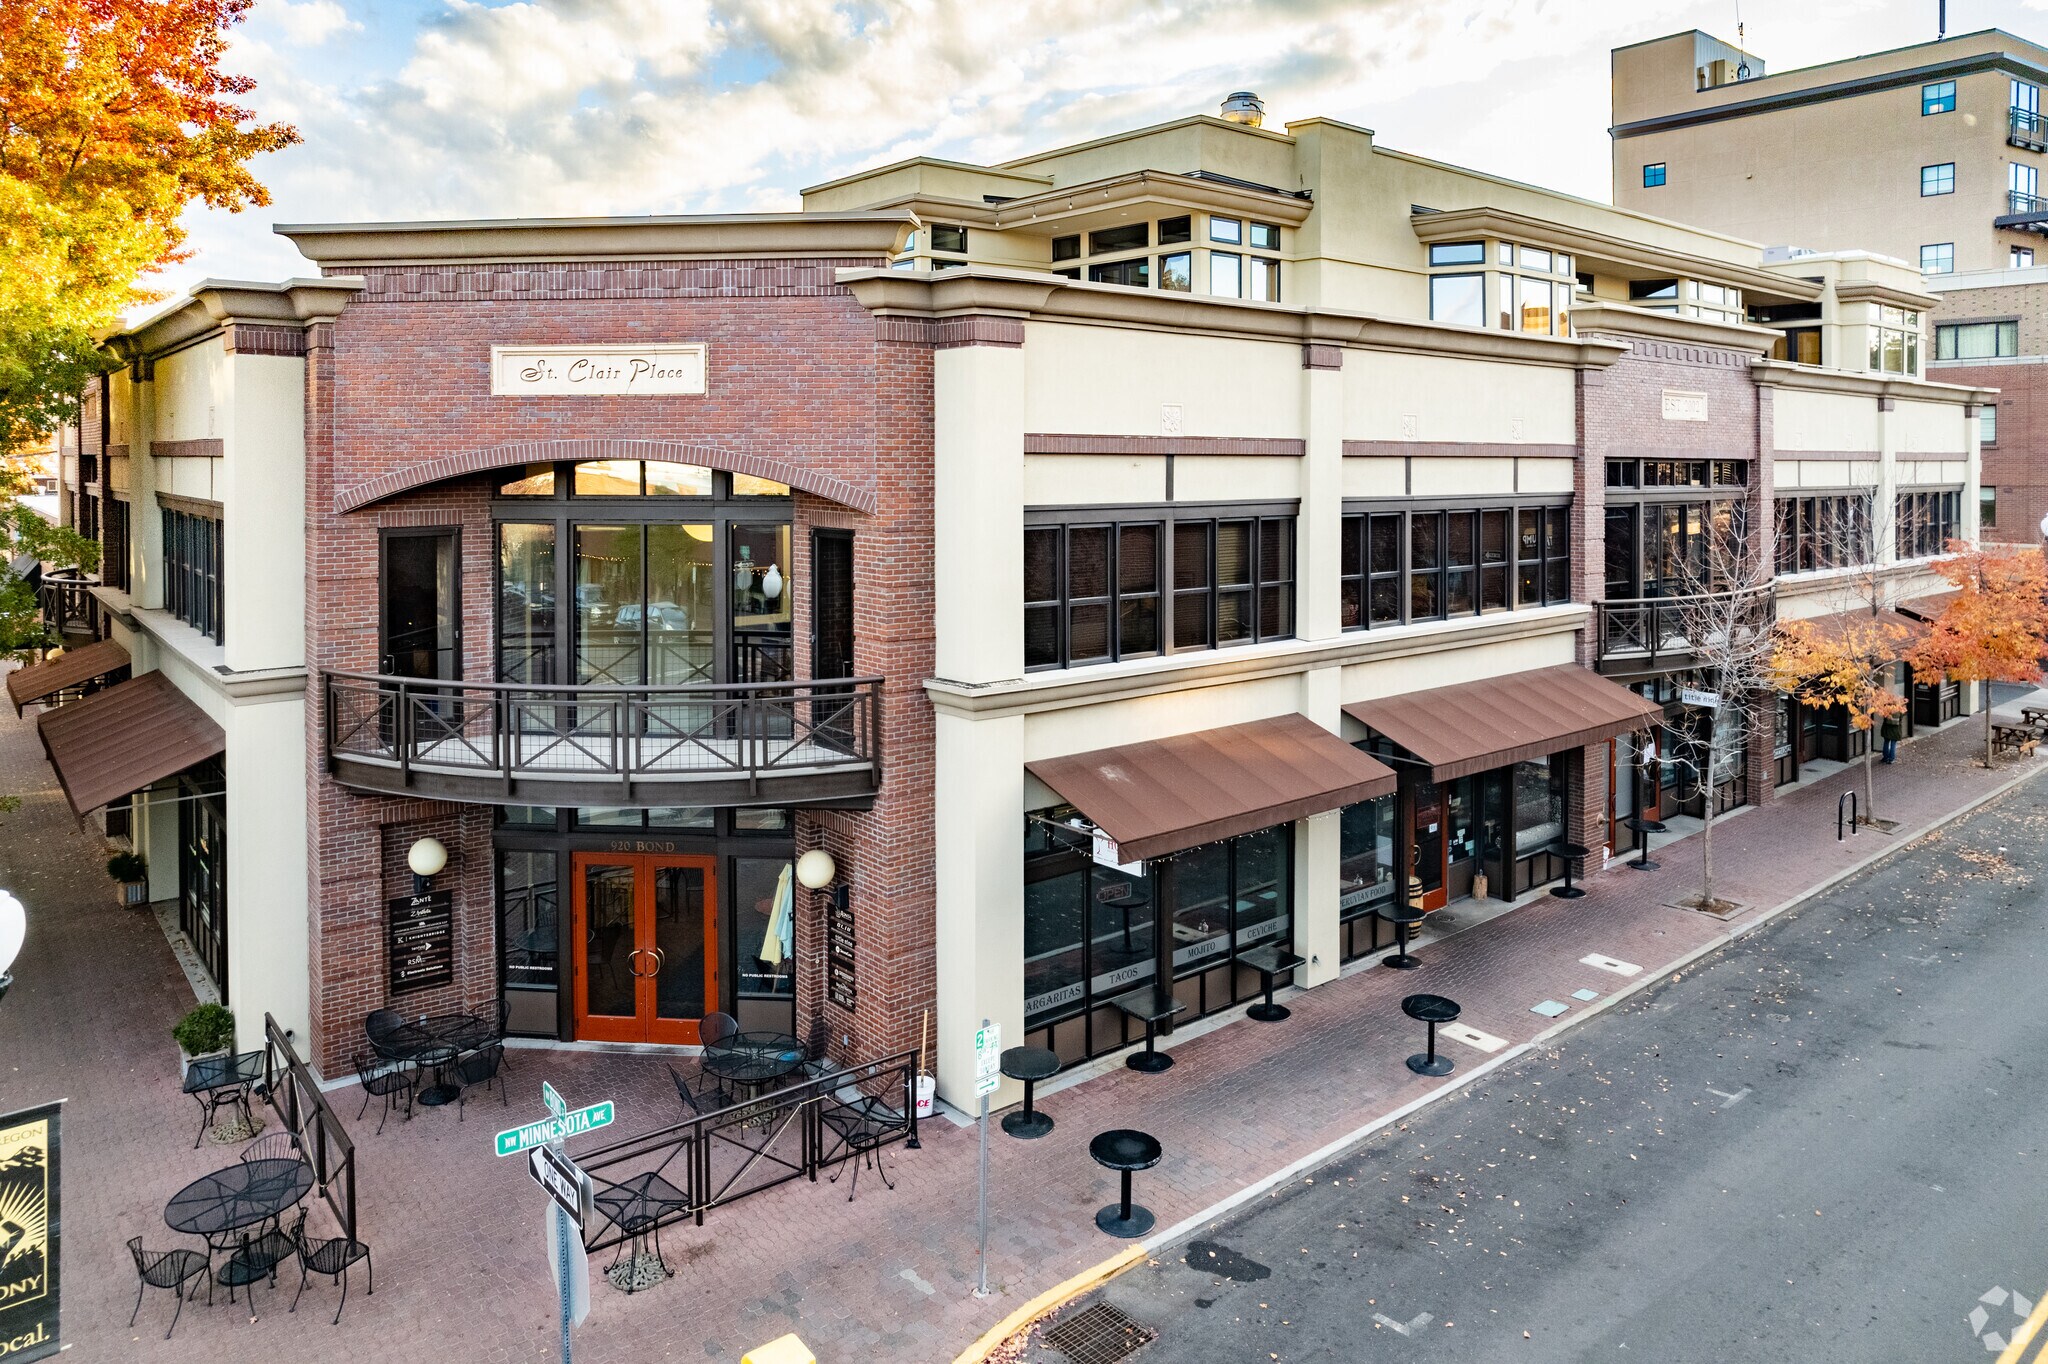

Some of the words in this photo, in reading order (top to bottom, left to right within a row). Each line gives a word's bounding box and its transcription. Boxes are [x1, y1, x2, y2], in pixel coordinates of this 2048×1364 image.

[520, 359, 558, 383] St.
[567, 358, 621, 383] Clair
[629, 358, 683, 383] Place
[611, 840, 631, 852] 920
[636, 841, 675, 853] BOND
[1100, 884, 1128, 901] OPEN
[1370, 886, 1386, 898] FOOD
[1247, 921, 1278, 940] CEVICHE
[1187, 941, 1216, 959] MOJITO
[1109, 967, 1138, 985] TACOS
[916, 1099, 930, 1108] CE
[505, 1135, 517, 1149] NW
[519, 1111, 590, 1148] MINNESOTA
[593, 1109, 606, 1123] AVE
[544, 1161, 558, 1189] ONE
[560, 1180, 576, 1207] WAY
